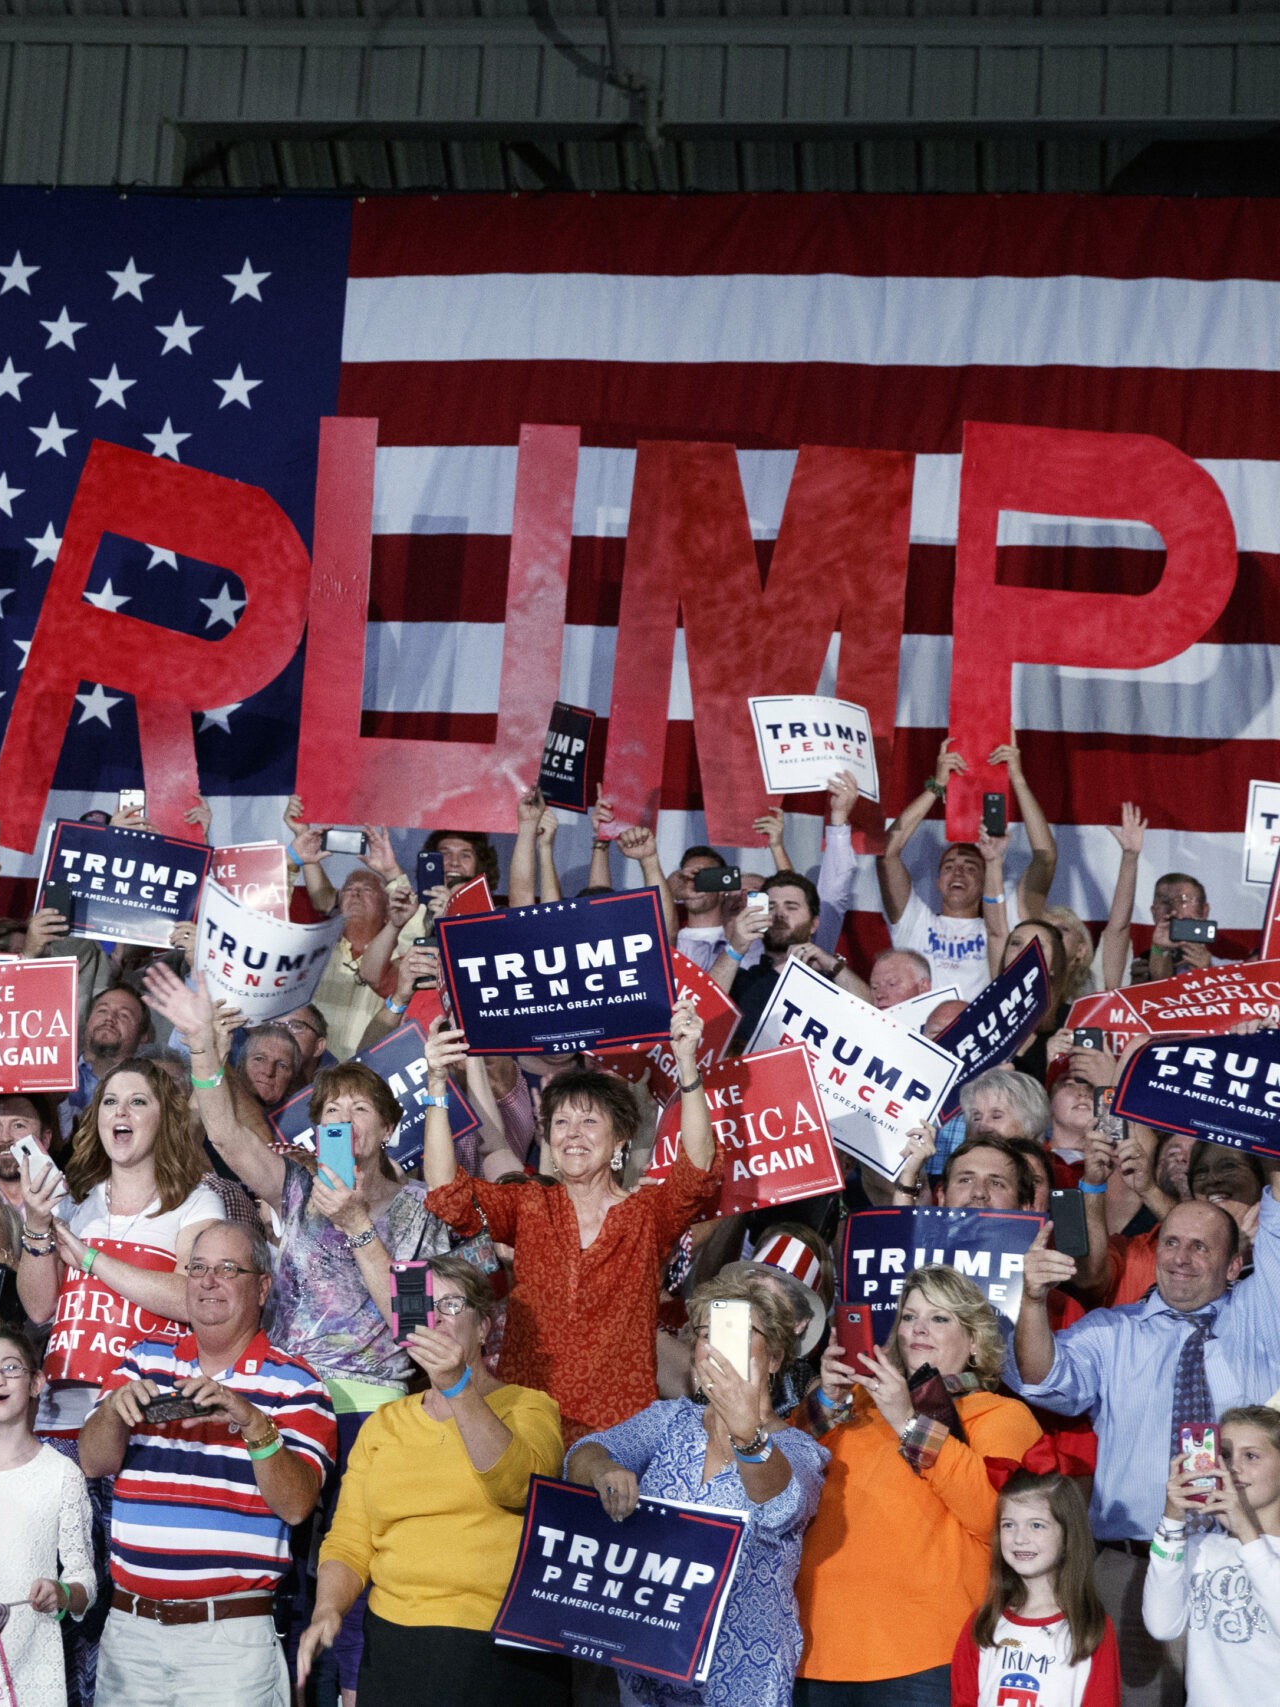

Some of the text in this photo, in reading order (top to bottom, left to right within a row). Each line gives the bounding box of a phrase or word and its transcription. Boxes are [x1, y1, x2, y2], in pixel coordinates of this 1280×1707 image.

[545, 731, 585, 756] UMP
[766, 722, 866, 744] TRUMP
[780, 742, 863, 759] PENCE
[60, 849, 197, 889] TRUMP
[67, 873, 179, 904] PENCE
[84, 893, 120, 904] AMERICA
[122, 900, 148, 909] GREAT
[151, 904, 179, 915] AGAIN!
[458, 933, 653, 983] TRUMP
[480, 969, 639, 1003] PENCE
[1182, 972, 1246, 991] MAKE
[479, 992, 647, 1017] MAKE AMERICA GREAT AGAIN!
[957, 966, 1039, 1058] RUMP
[1140, 982, 1280, 1015] AMERIC
[1158, 1002, 1280, 1022] GREAT AGA
[969, 992, 1034, 1063] ENCE
[1109, 1009, 1138, 1024] MA
[553, 1040, 586, 1051] 2016
[781, 998, 932, 1102] TRUMP
[646, 1044, 681, 1083] AGA
[1151, 1046, 1280, 1088] TRU
[1148, 1080, 1276, 1120] MAKE AMERICA GREAT
[1158, 1064, 1280, 1108] PENC
[293, 1058, 428, 1152] TMP
[832, 1092, 898, 1134] GREAT AGAIN!
[1207, 1132, 1242, 1146] 2016
[733, 1143, 815, 1182] AGAIN
[864, 1280, 1008, 1302] PEE
[47, 1330, 85, 1353] EAT
[537, 1525, 715, 1591] TRUMP
[542, 1565, 686, 1614] PENCE
[531, 1588, 681, 1631] MAKE AMERICA GREAT AGAIN!
[572, 1644, 604, 1660] 2016
[1002, 1646, 1056, 1674] TRUMP
